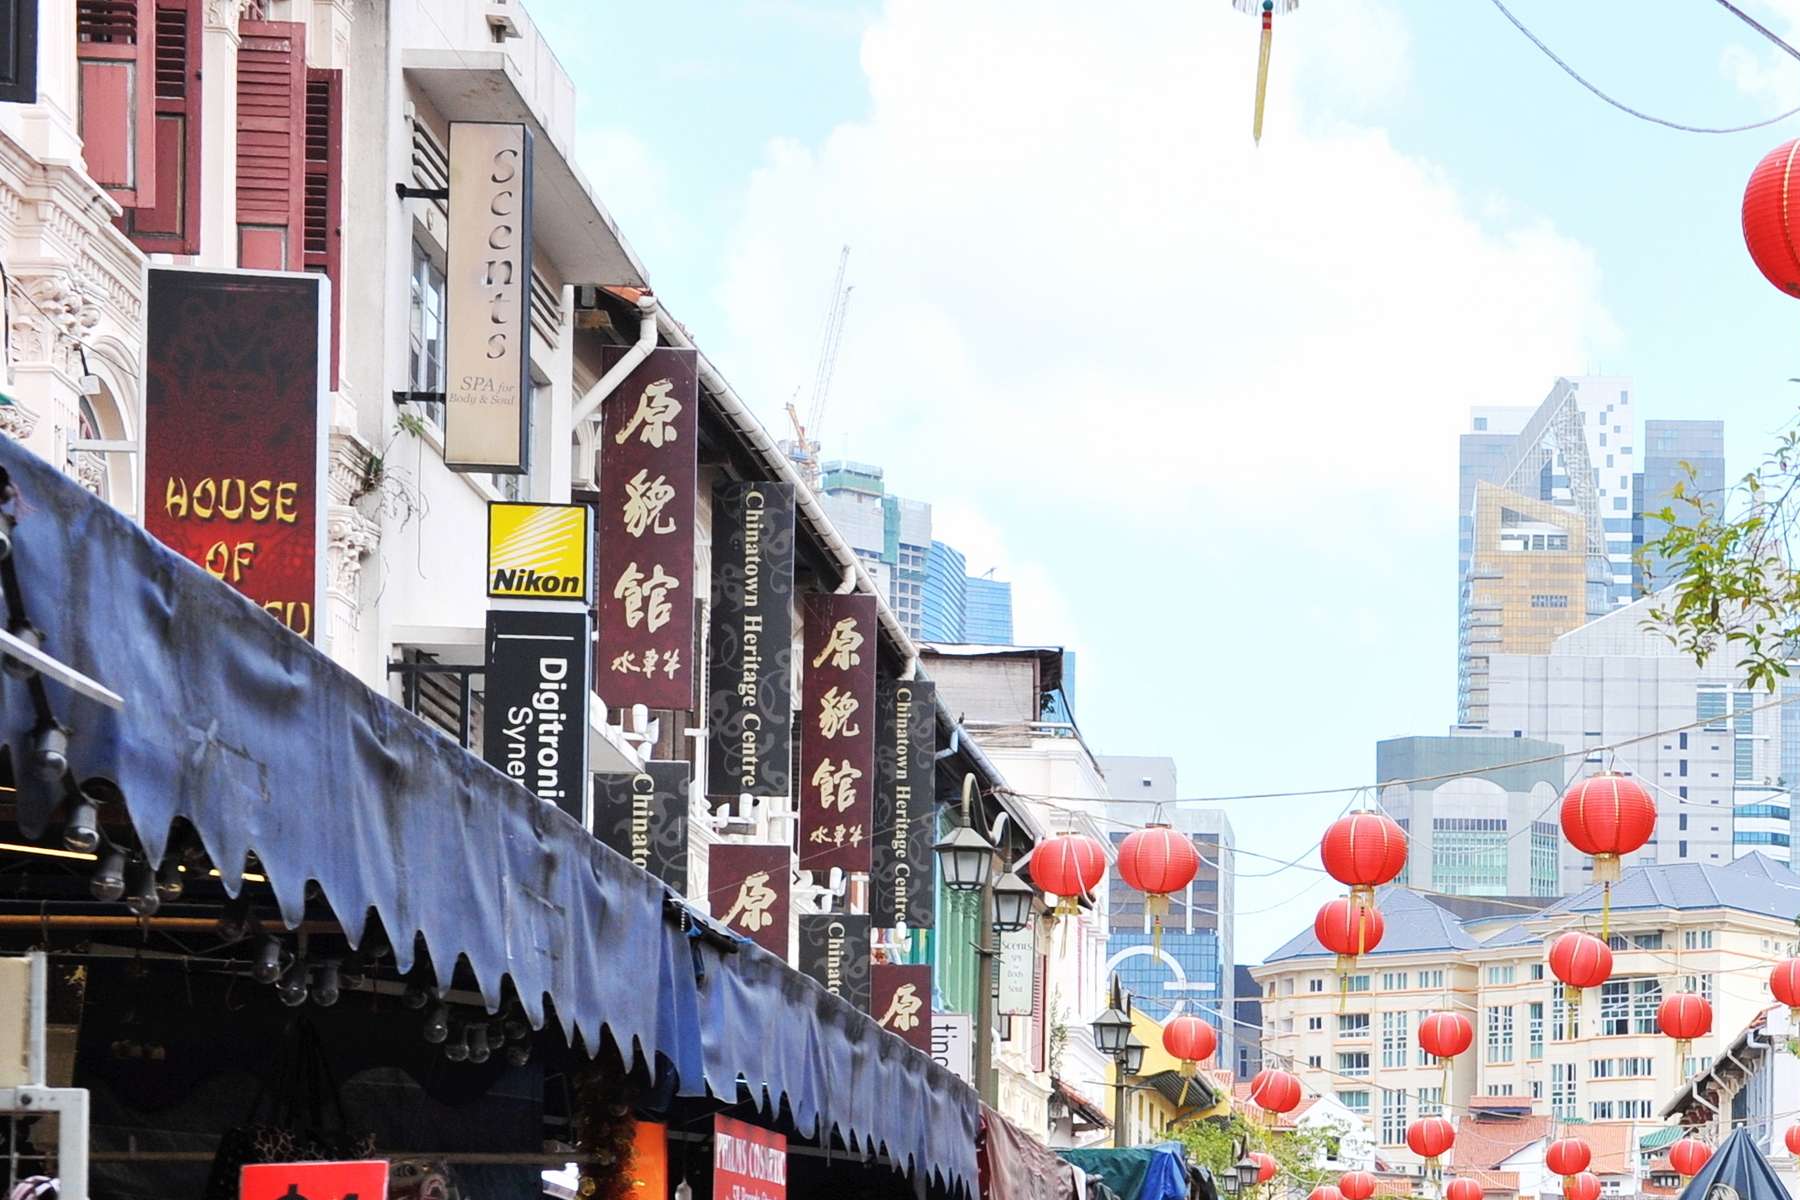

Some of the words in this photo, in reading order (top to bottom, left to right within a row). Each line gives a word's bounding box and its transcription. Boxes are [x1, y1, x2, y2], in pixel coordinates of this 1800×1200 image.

[485, 150, 517, 359] Scents
[460, 376, 495, 391] SPA
[165, 476, 298, 523] HOUSE
[205, 541, 255, 582] OF
[493, 568, 579, 594] Nikon
[744, 490, 765, 607] Chinatown
[738, 615, 762, 707] Heritage
[532, 658, 567, 806] Digitroni
[741, 713, 761, 788] Centre
[896, 687, 912, 780] Chinatown
[891, 785, 912, 858] Heritage
[720, 871, 777, 932] 原
[894, 862, 911, 924] Centre
[878, 983, 923, 1032] 原
